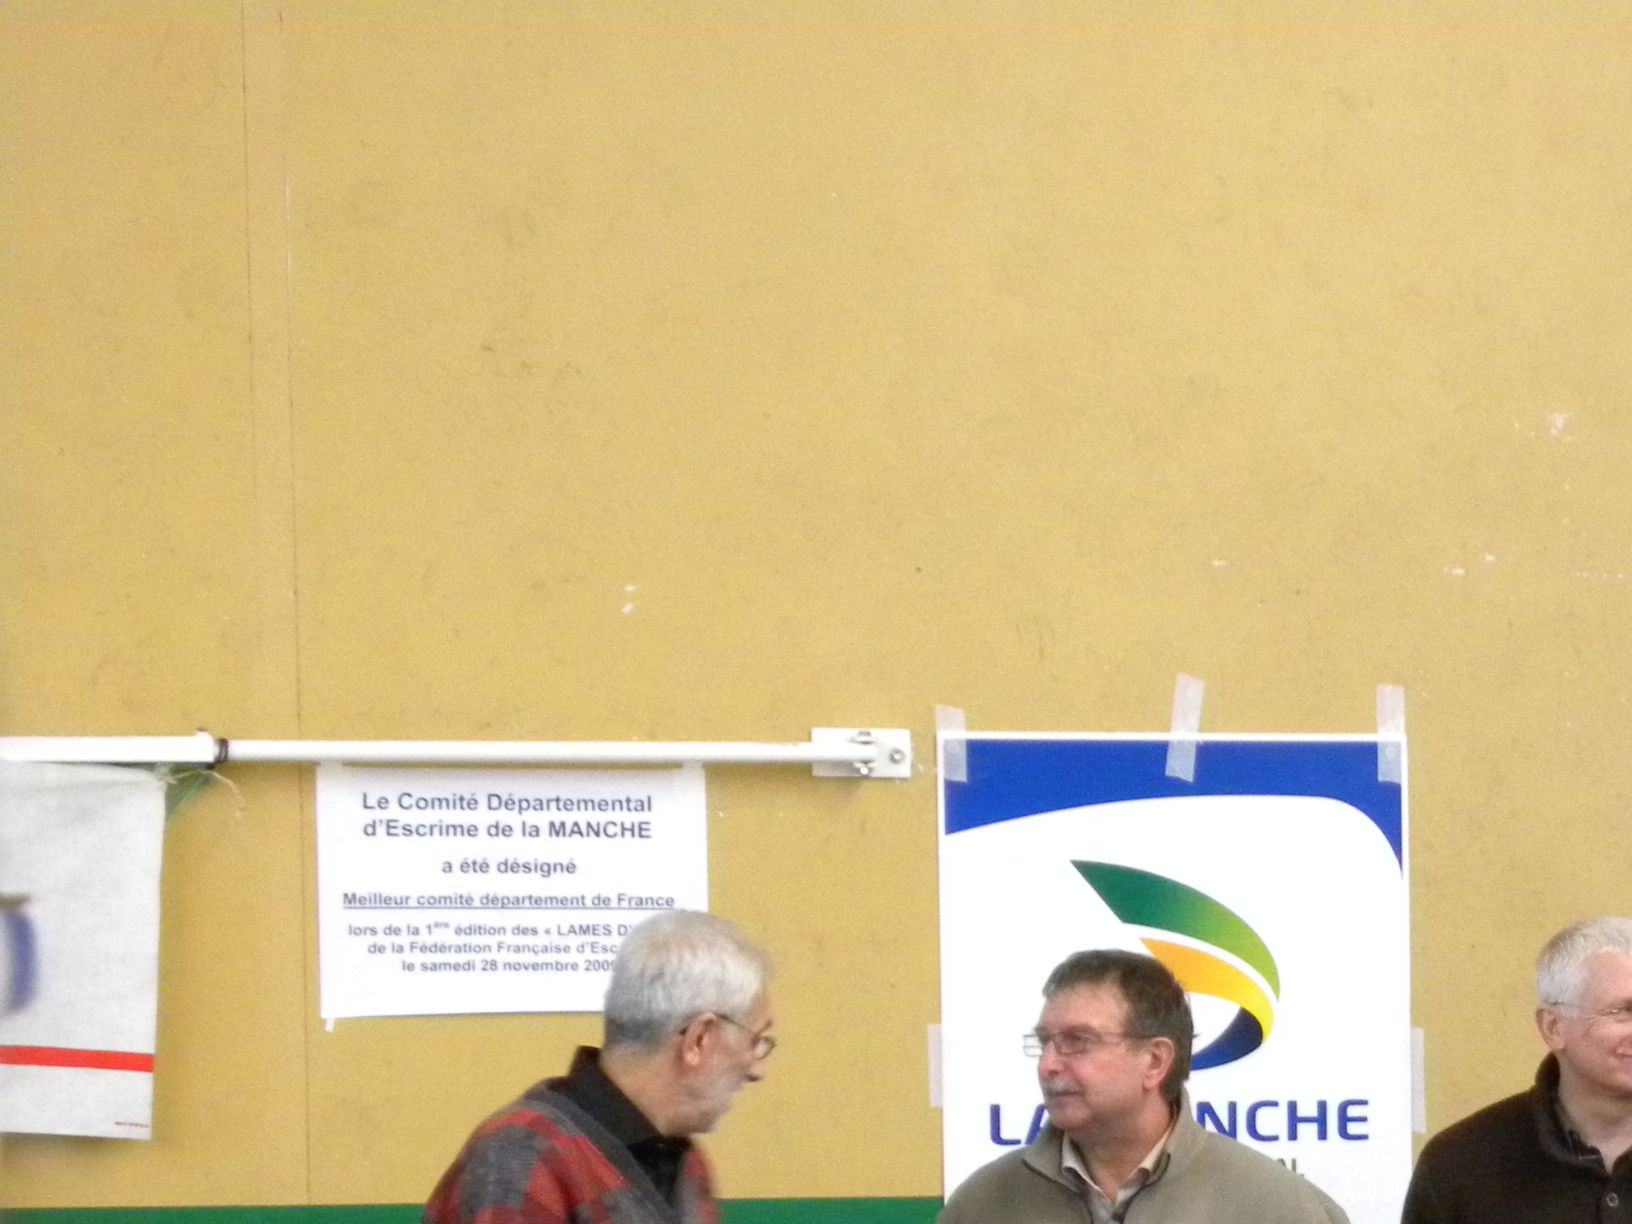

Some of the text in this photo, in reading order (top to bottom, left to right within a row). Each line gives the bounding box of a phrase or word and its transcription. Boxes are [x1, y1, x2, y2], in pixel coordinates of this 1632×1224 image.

[362, 791, 652, 815] Le Comité Départemental
[487, 820, 514, 838] de
[521, 820, 540, 838] la
[548, 820, 653, 839] MANCHE
[441, 857, 577, 878] a été désigné
[342, 892, 675, 909] Meilleur comité département de France
[348, 923, 378, 936] lors
[383, 923, 402, 936] de
[407, 923, 420, 936] la
[454, 923, 507, 936] édition
[511, 923, 539, 936] des
[557, 923, 612, 937] LAMES
[367, 941, 618, 956] de la Fédération Française d'Esc
[402, 959, 416, 972] le
[420, 959, 477, 972] samedi
[480, 959, 499, 972] 28
[503, 959, 580, 972] novembre
[1195, 1098, 1370, 1142] NCHE
